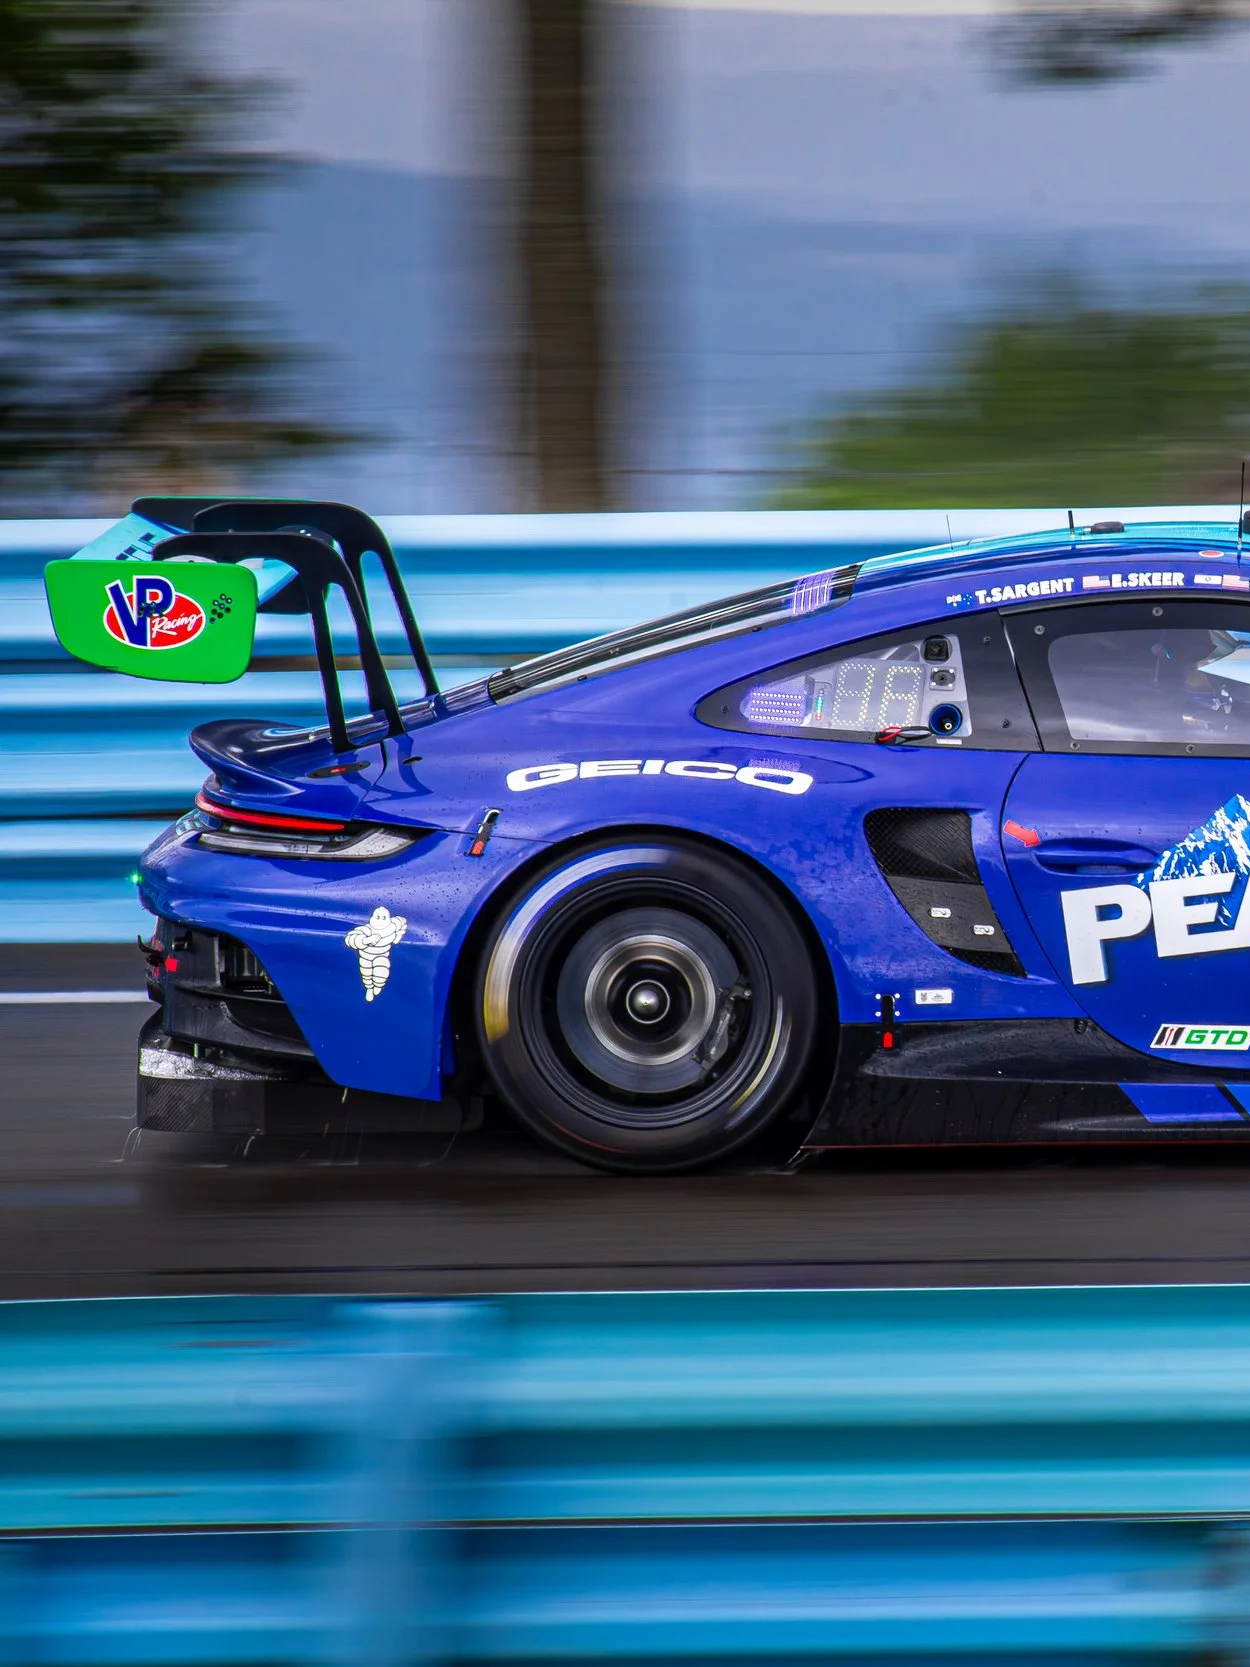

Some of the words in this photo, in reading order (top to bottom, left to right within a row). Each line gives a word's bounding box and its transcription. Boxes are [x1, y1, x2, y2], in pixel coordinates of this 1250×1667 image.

[975, 578, 1074, 605] T.SARGENT
[1111, 572, 1185, 587] E.SKEER
[106, 577, 175, 648] VP
[152, 613, 205, 639] Racing
[506, 760, 814, 795] GEICO
[1184, 1029, 1250, 1045] GTD
